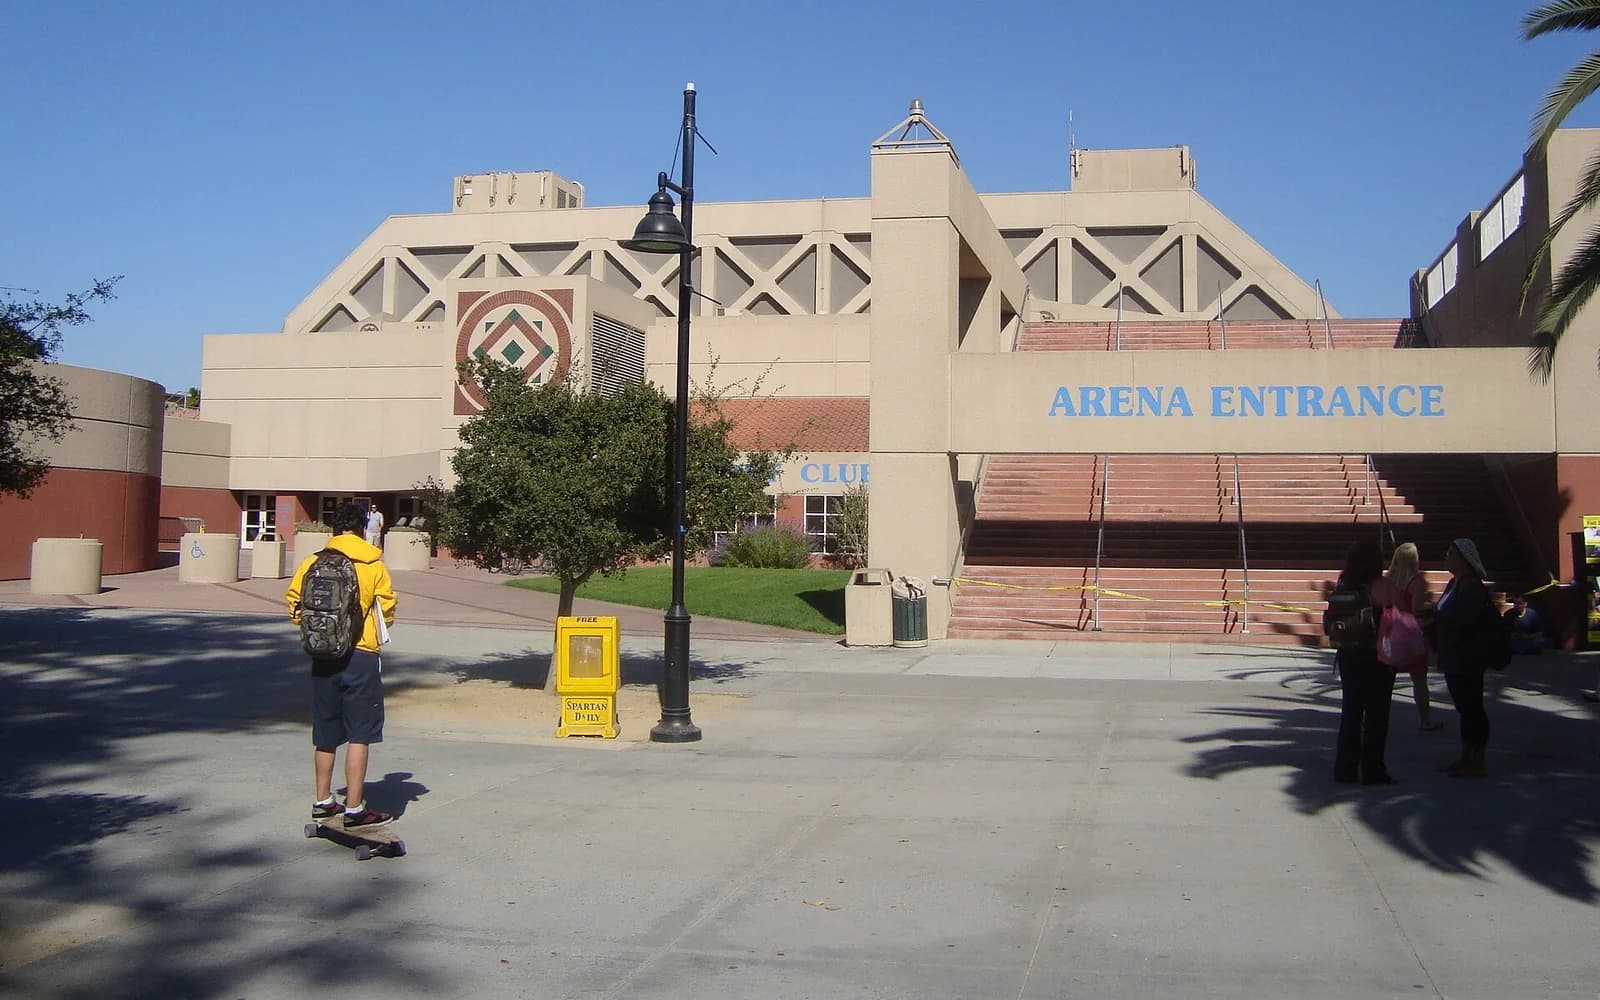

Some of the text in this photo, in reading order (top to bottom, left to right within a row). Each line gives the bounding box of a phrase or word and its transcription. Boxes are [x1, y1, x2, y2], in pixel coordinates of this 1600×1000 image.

[1048, 385, 1446, 417] ARENA ENTRANCE
[566, 701, 608, 711] SPARTAN
[575, 712, 600, 721] DAILY
